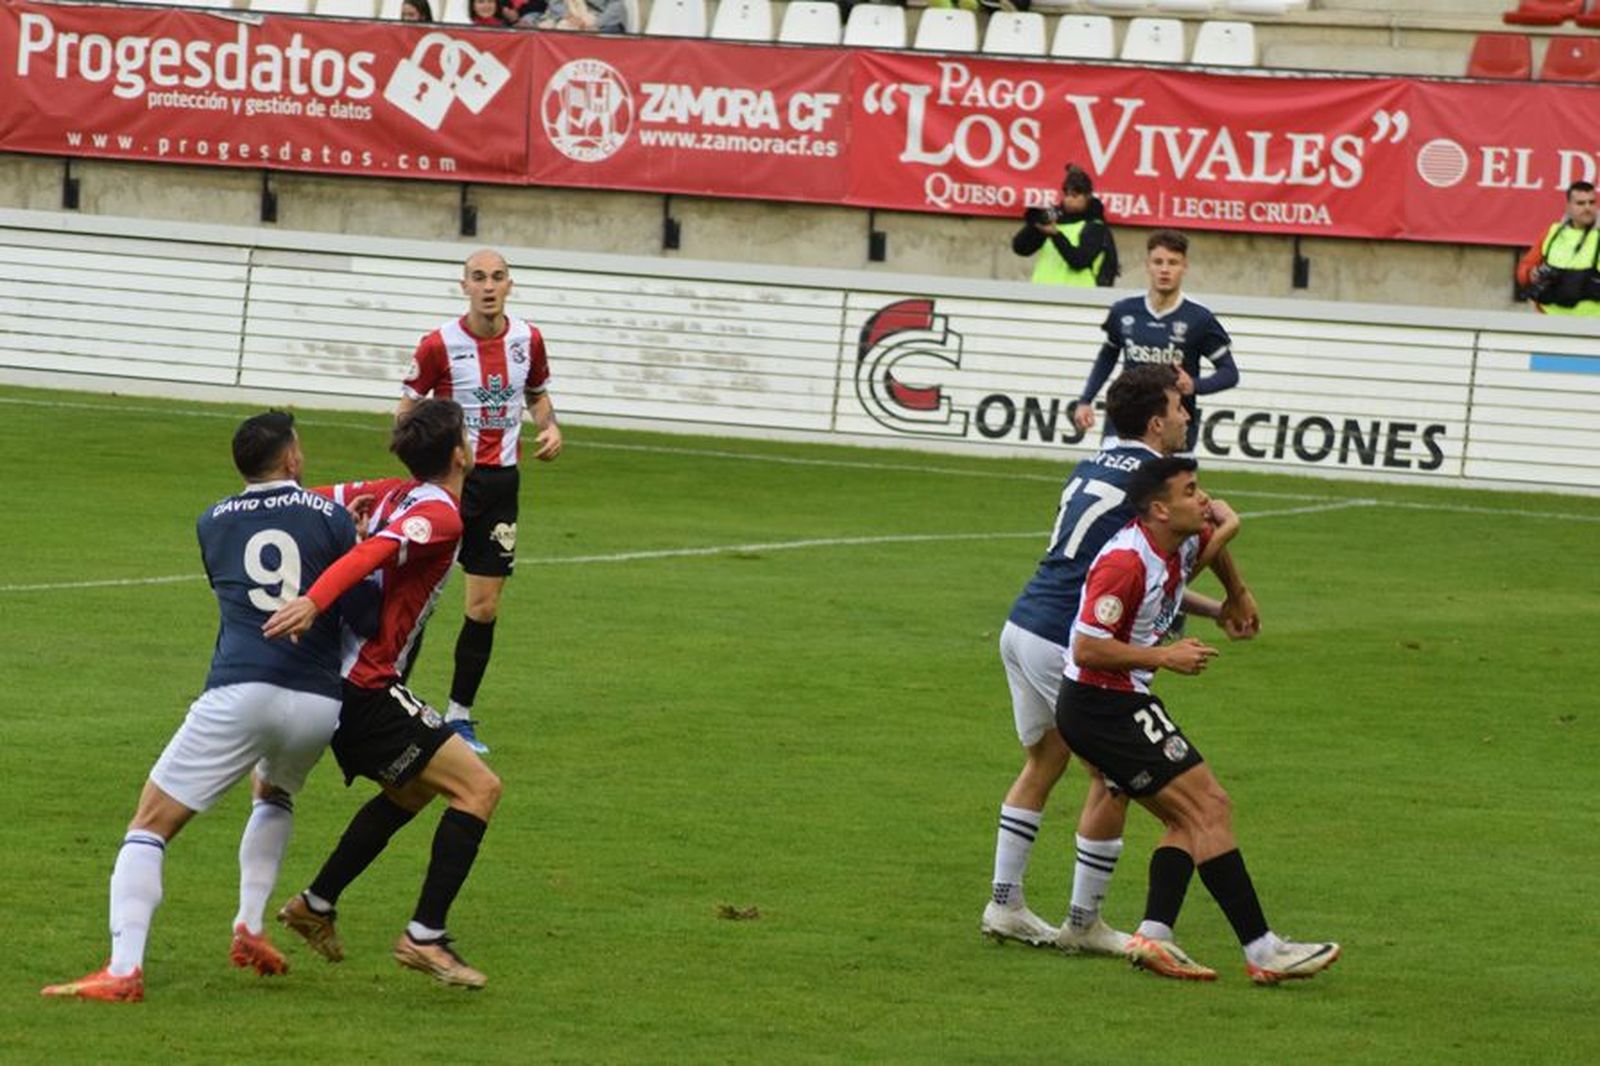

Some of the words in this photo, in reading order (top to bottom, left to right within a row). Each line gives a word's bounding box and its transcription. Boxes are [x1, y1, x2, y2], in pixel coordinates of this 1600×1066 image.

[17, 13, 376, 99] Progesdatos
[148, 91, 228, 111] protección
[231, 98, 241, 115] y
[245, 95, 302, 116] gestión
[306, 99, 326, 118] de
[330, 100, 373, 120] datos
[640, 83, 780, 130] ZAMORA
[788, 92, 841, 131] CF
[937, 62, 1045, 111] PAGO
[67, 131, 457, 172] www.progesdatos.com
[639, 129, 838, 157] www.zamoracf.es
[1476, 146, 1543, 190] EL
[1554, 149, 1600, 192] D
[925, 172, 1016, 207] QUESO
[1024, 187, 1059, 209] DE
[1092, 192, 1152, 218] VEJA
[1173, 197, 1245, 221] LECHE
[1250, 200, 1332, 225] CRUDA
[212, 499, 260, 517] DAVID
[264, 492, 335, 517] GRANDE
[1047, 478, 1127, 560] 17
[243, 529, 302, 612] 9
[1133, 703, 1176, 744] 21
